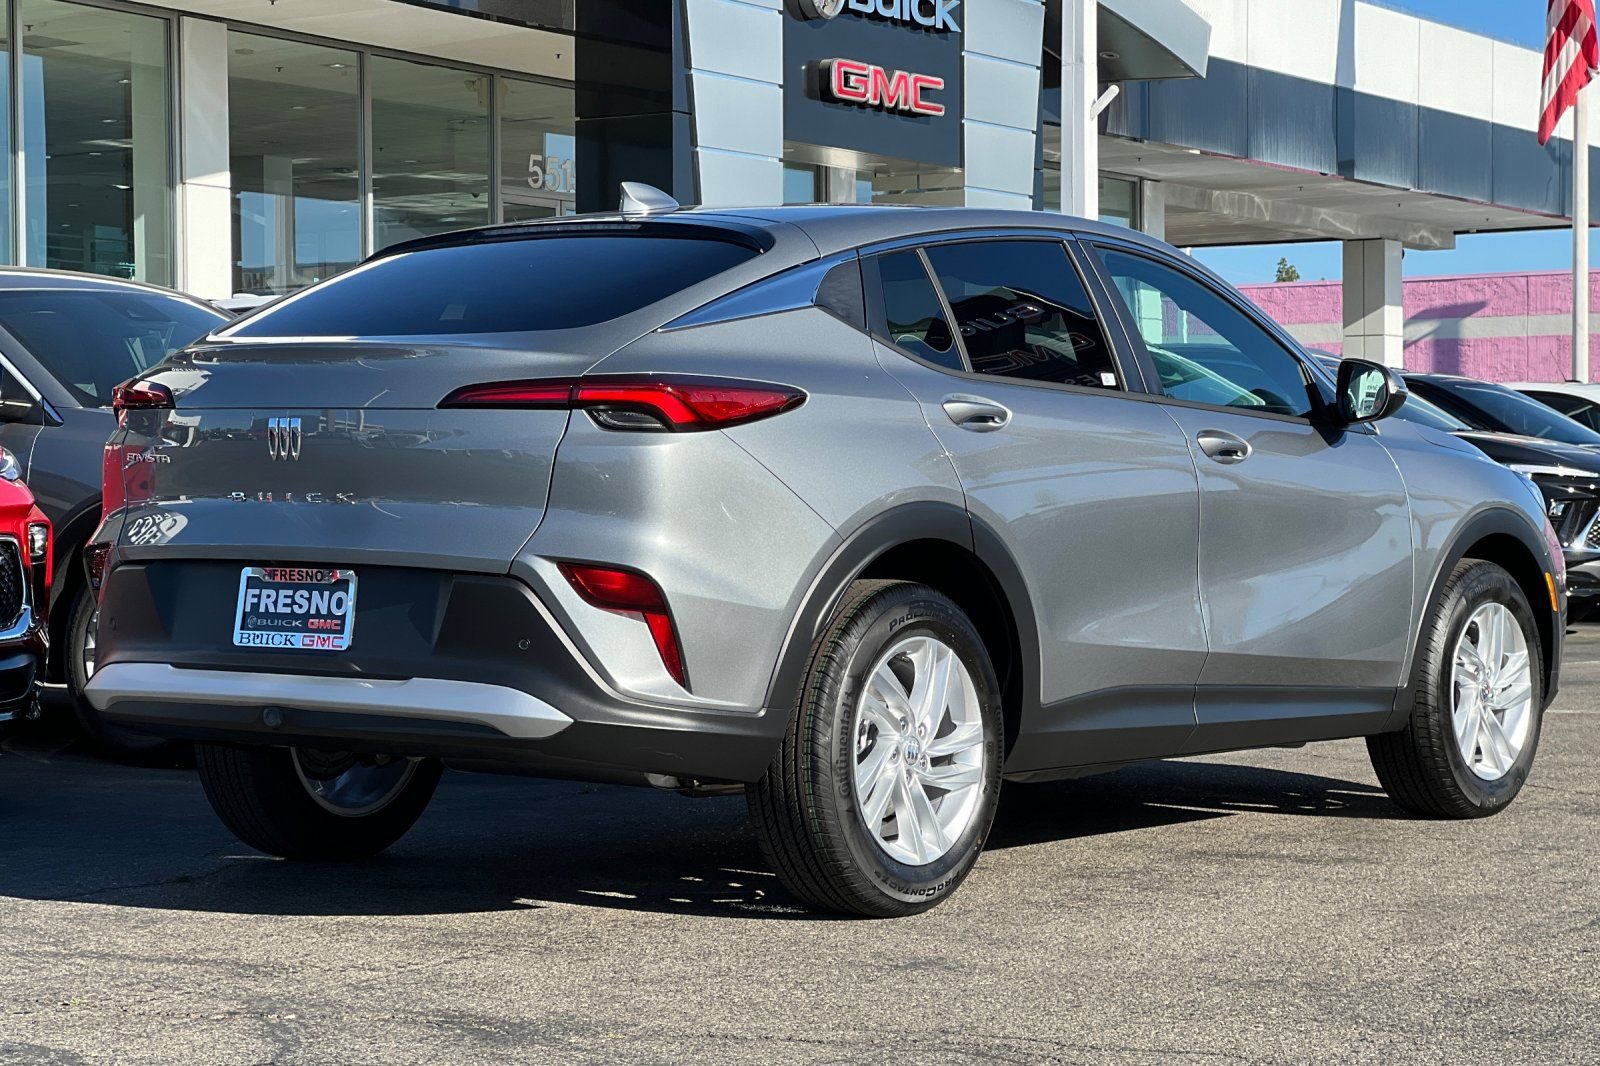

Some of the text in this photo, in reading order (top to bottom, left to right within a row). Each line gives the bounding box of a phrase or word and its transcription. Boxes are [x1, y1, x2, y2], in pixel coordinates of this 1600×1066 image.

[830, 58, 945, 117] GMC
[527, 153, 576, 193] 551
[272, 569, 324, 582] FRESNO
[244, 588, 347, 615] FRESNO
[257, 618, 341, 630] BUICK GMC
[238, 632, 344, 649] BUICK GMC
